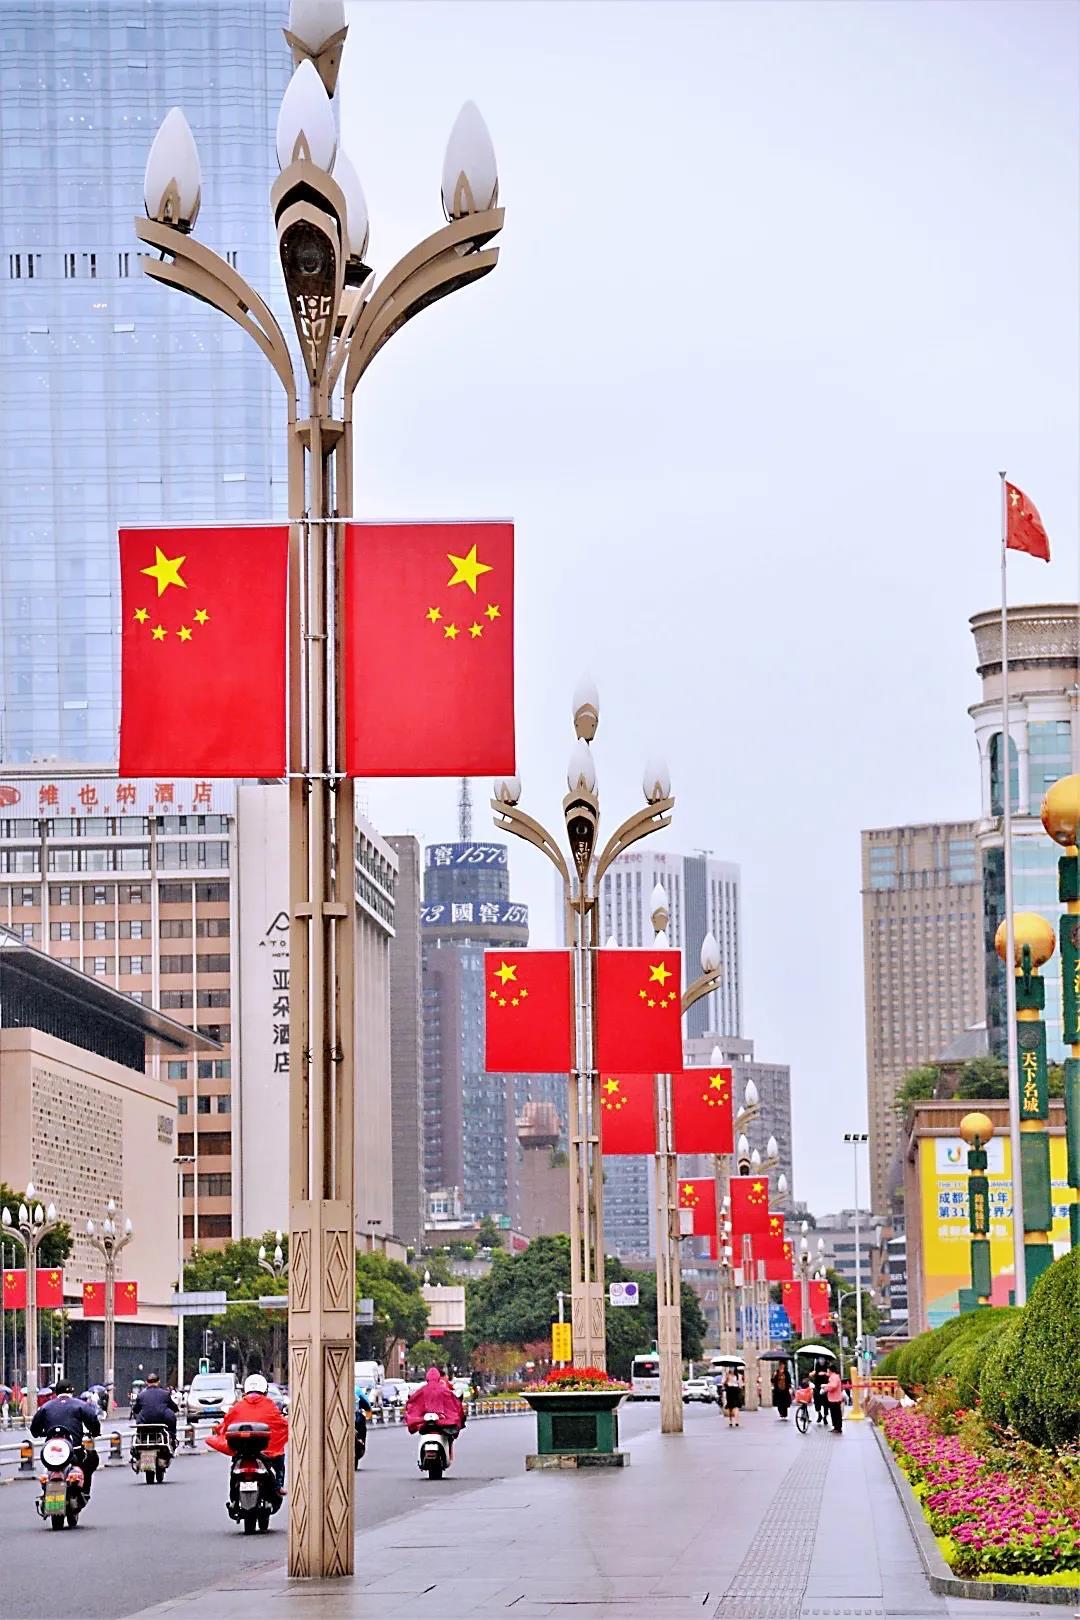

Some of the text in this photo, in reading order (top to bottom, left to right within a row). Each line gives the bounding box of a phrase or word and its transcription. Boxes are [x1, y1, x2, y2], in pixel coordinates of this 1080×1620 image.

[39, 782, 213, 806] 维也纳酒店
[149, 804, 212, 813] HOTEL
[272, 969, 290, 1073] 亚朵酒店
[1022, 1052, 1039, 1112] 天下名城
